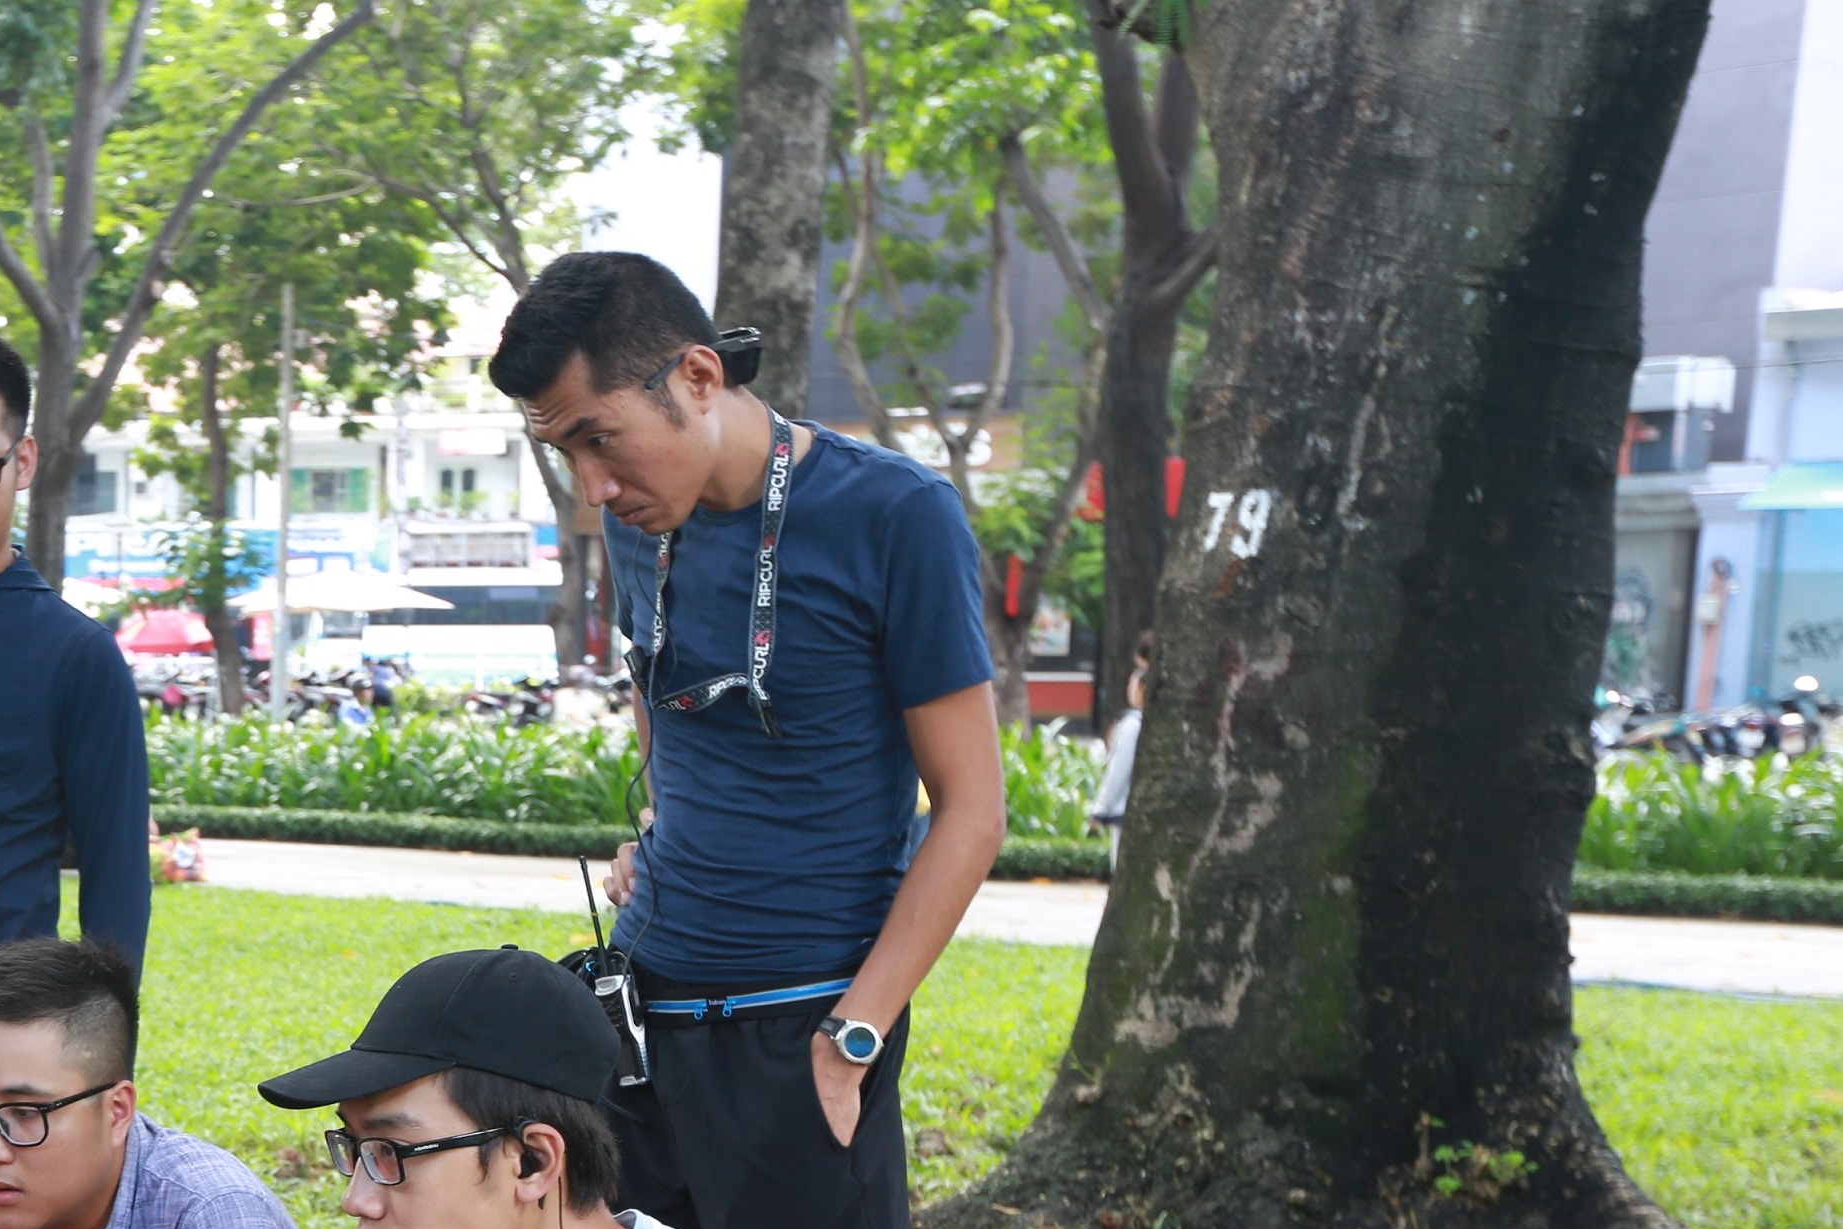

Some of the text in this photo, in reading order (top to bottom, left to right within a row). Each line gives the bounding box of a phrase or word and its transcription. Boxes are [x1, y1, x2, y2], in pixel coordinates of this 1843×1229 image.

[767, 455, 789, 512] RIPCURL
[1203, 488, 1272, 559] 79
[757, 545, 773, 607] RIPCURL
